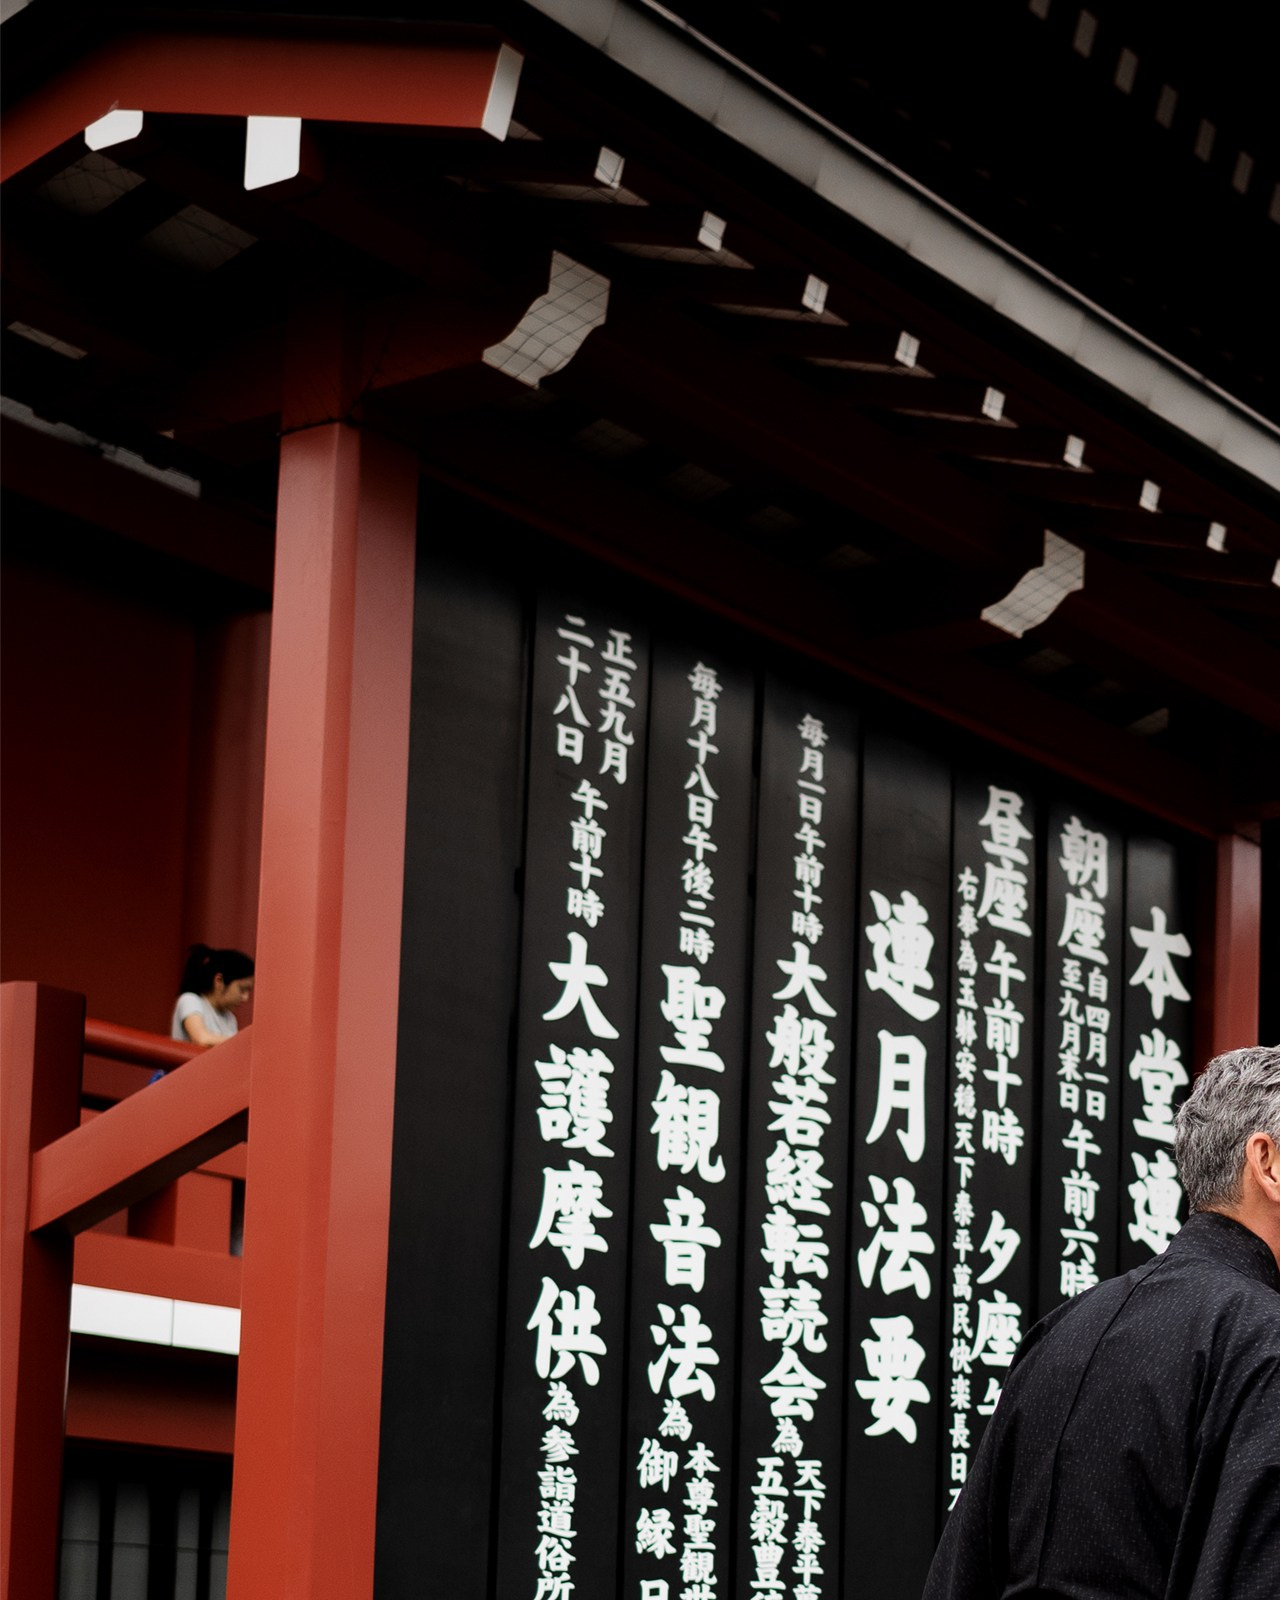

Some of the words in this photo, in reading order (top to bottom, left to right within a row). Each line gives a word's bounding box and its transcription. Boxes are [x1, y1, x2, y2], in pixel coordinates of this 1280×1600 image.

[553, 616, 595, 765] 二十八日
[598, 630, 638, 785] 正五九月
[567, 779, 609, 928] 午前十時
[1058, 817, 1109, 965] 朝座
[980, 940, 1027, 1167] 午前十時
[1057, 957, 1084, 1113] 至九月末日
[1084, 967, 1111, 1121] 自四月一日
[527, 933, 620, 1388] 大護摩供
[647, 965, 727, 1402] 聖観音法
[758, 941, 838, 1420] 大般若経転読会
[854, 889, 940, 1443] 連月法要
